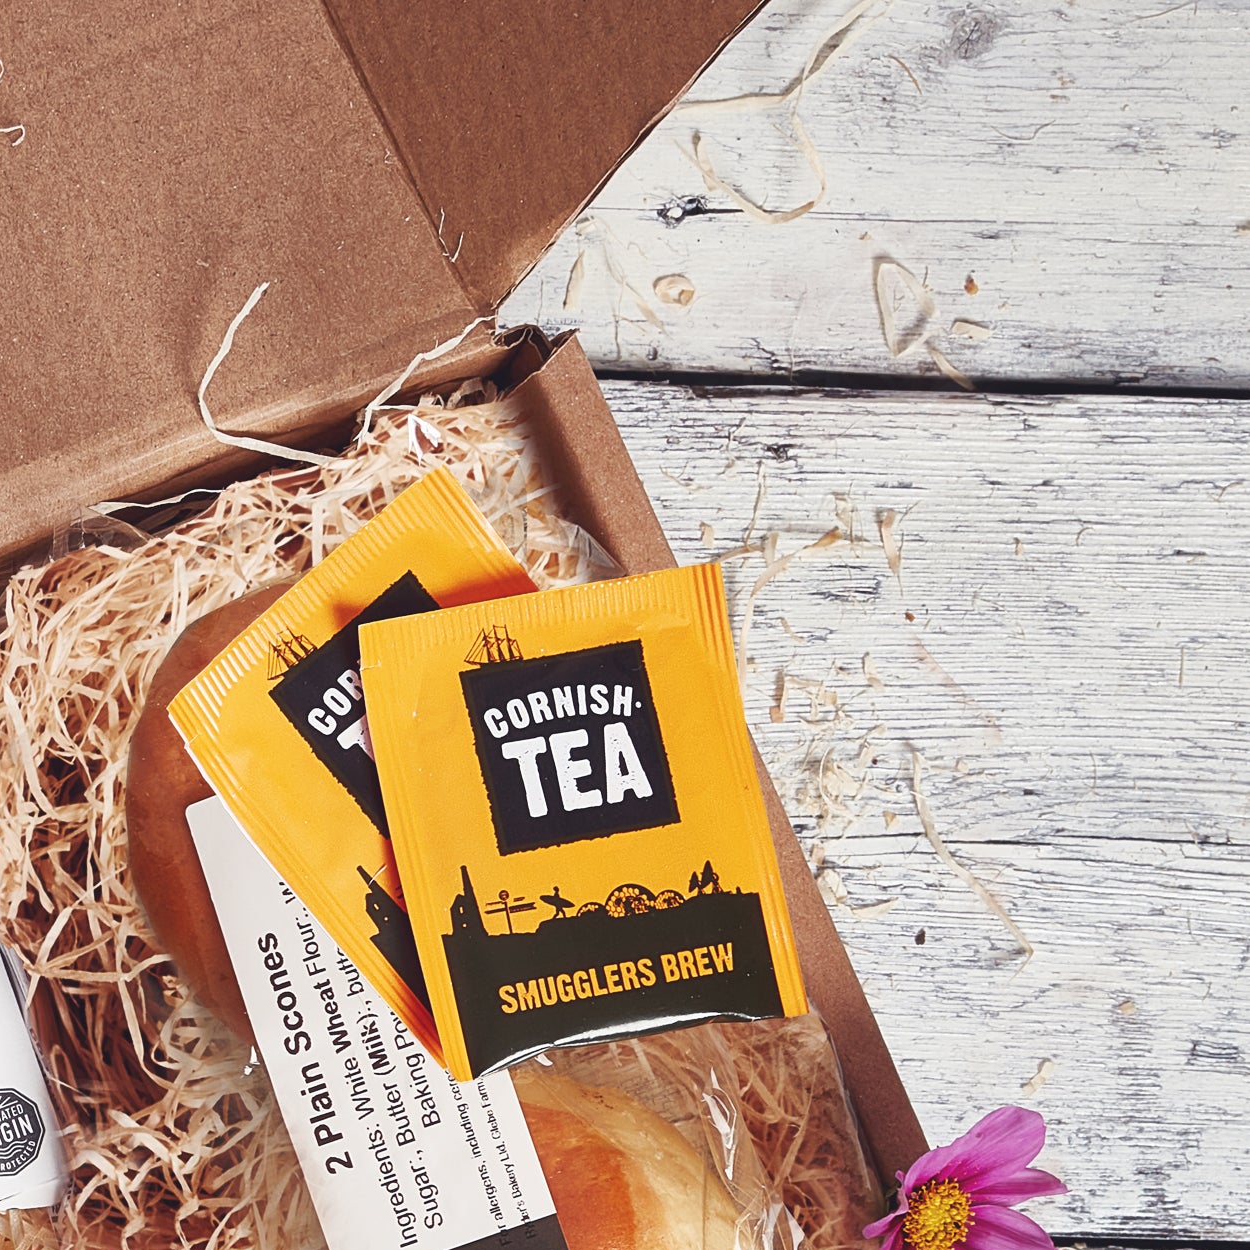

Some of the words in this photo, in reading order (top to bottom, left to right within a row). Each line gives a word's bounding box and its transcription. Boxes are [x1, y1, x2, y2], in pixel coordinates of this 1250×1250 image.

[502, 722, 653, 817] TEA
[258, 933, 311, 1055] Scones
[499, 959, 656, 1013] SMUGGLERS
[663, 943, 733, 982] BREW
[313, 979, 351, 1054] Wheat
[301, 1062, 343, 1146] Plain
[344, 1057, 374, 1120] White
[383, 1083, 415, 1146] Butter
[406, 1053, 441, 1128] Baking
[326, 1151, 353, 1174] 2
[457, 1104, 481, 1158] including
[369, 1124, 418, 1248] Ingredients:
[478, 1161, 503, 1220] allergens,
[504, 1164, 522, 1198] Bakery
